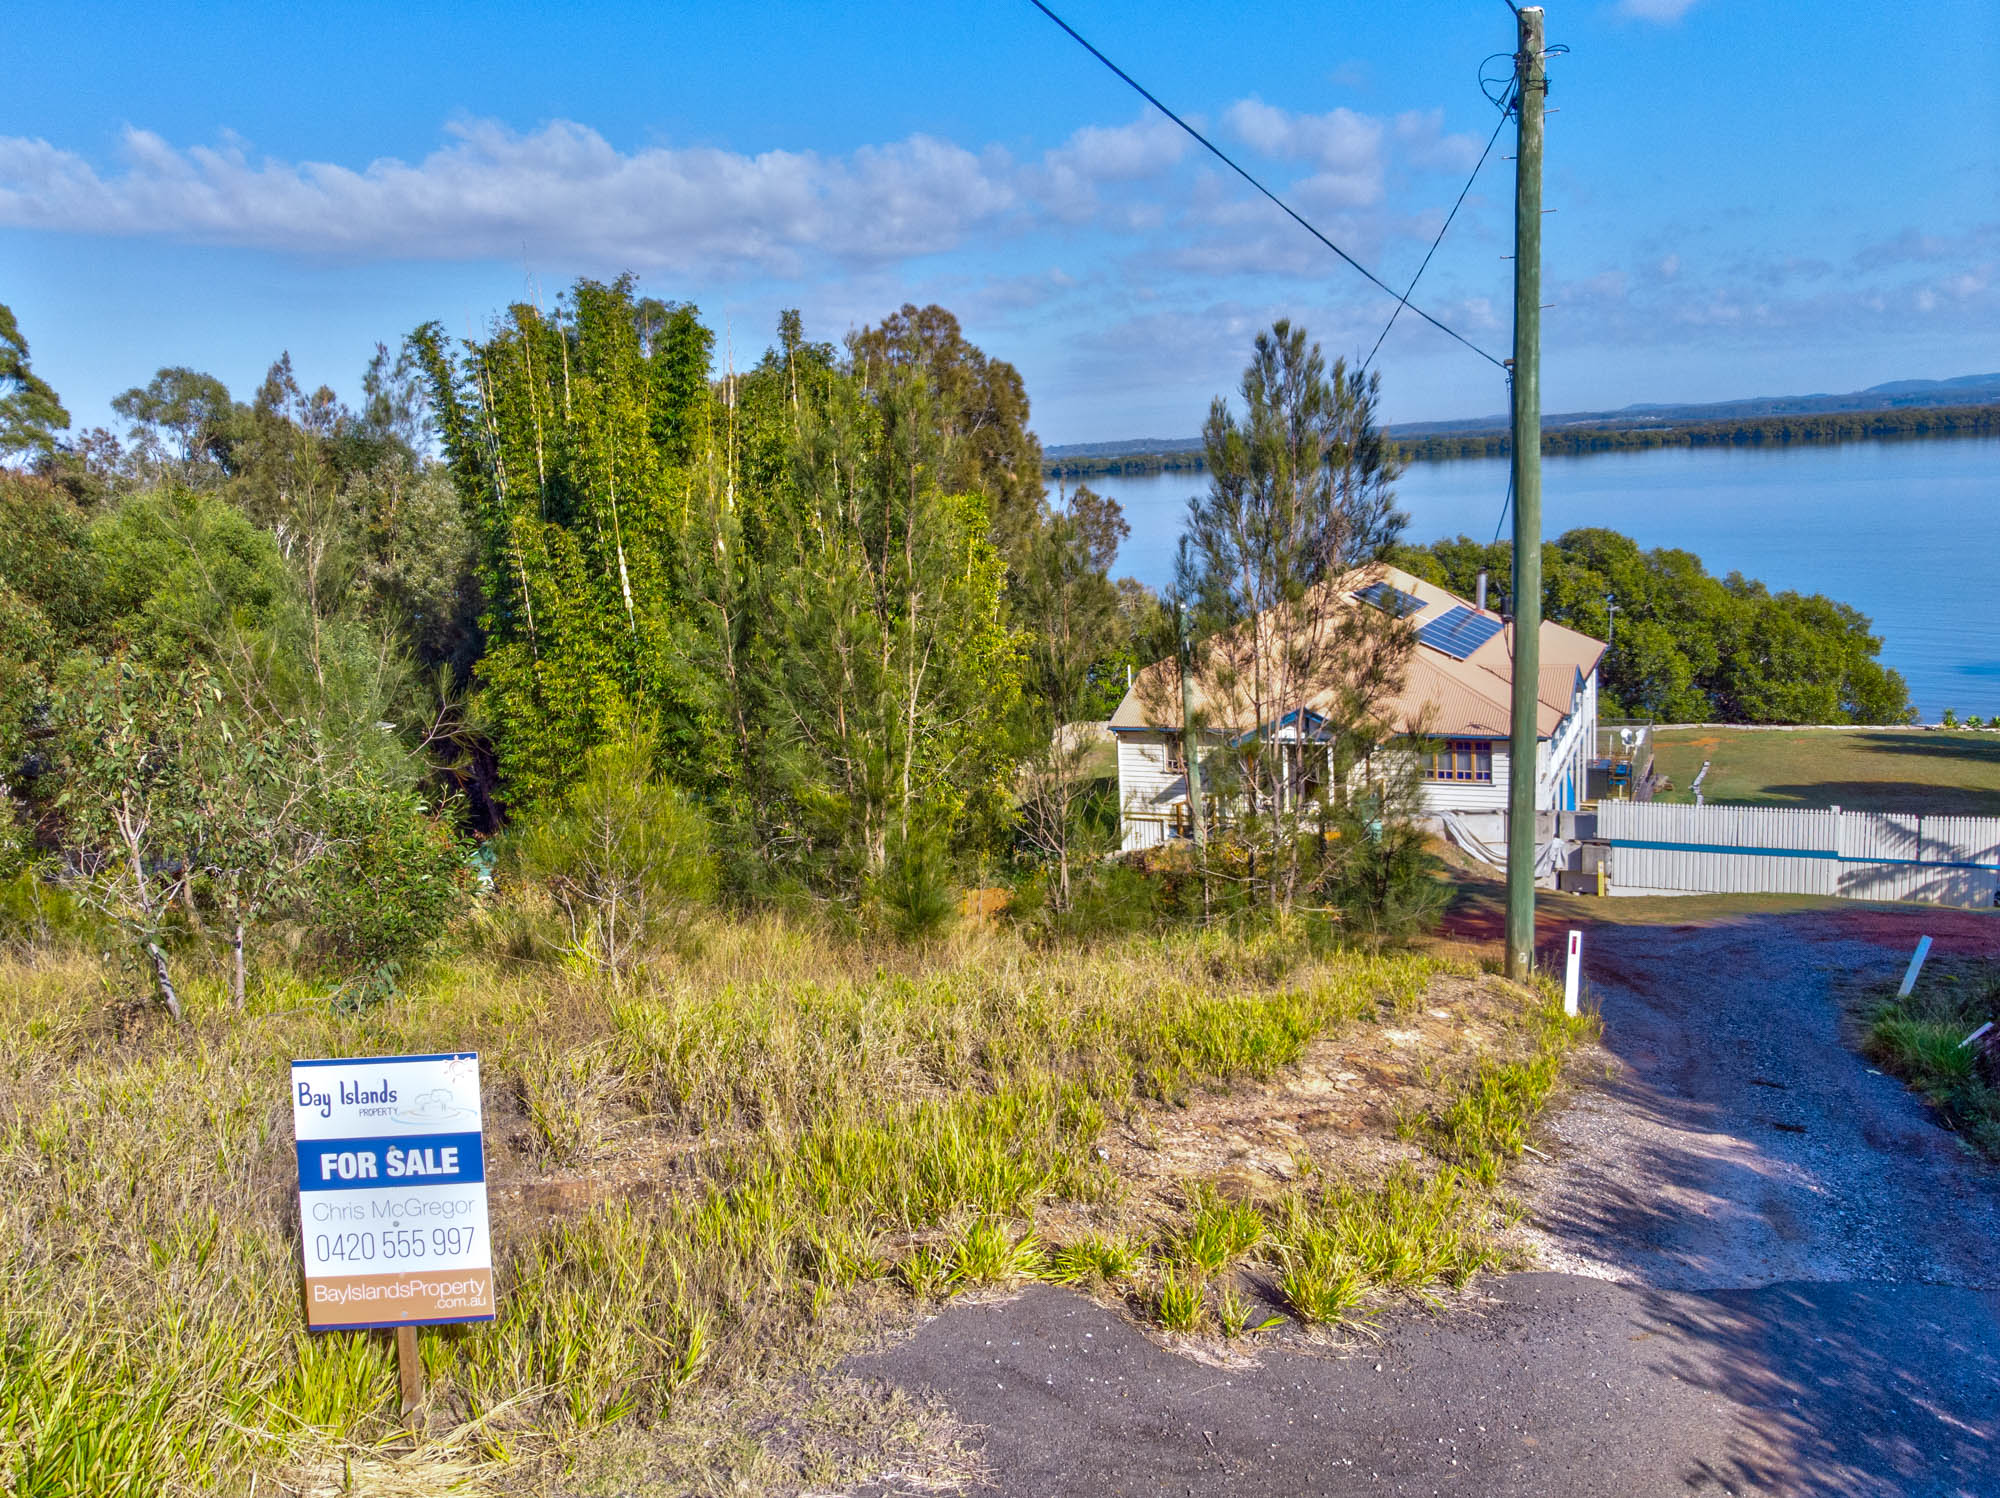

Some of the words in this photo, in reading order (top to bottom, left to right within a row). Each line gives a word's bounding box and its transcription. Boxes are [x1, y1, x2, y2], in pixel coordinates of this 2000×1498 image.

[298, 1082, 331, 1118] Bay
[340, 1079, 397, 1105] Islands
[360, 1107, 397, 1117] PROPERTY
[321, 1152, 377, 1180] FOR
[386, 1147, 459, 1176] SALE
[312, 1203, 365, 1221] Chris
[373, 1199, 475, 1219] McGregor
[317, 1232, 374, 1261] 0420
[383, 1230, 425, 1258] 555
[433, 1227, 474, 1255] 997
[314, 1278, 485, 1304] BayIslandsProperty
[434, 1296, 486, 1309] .com.au
